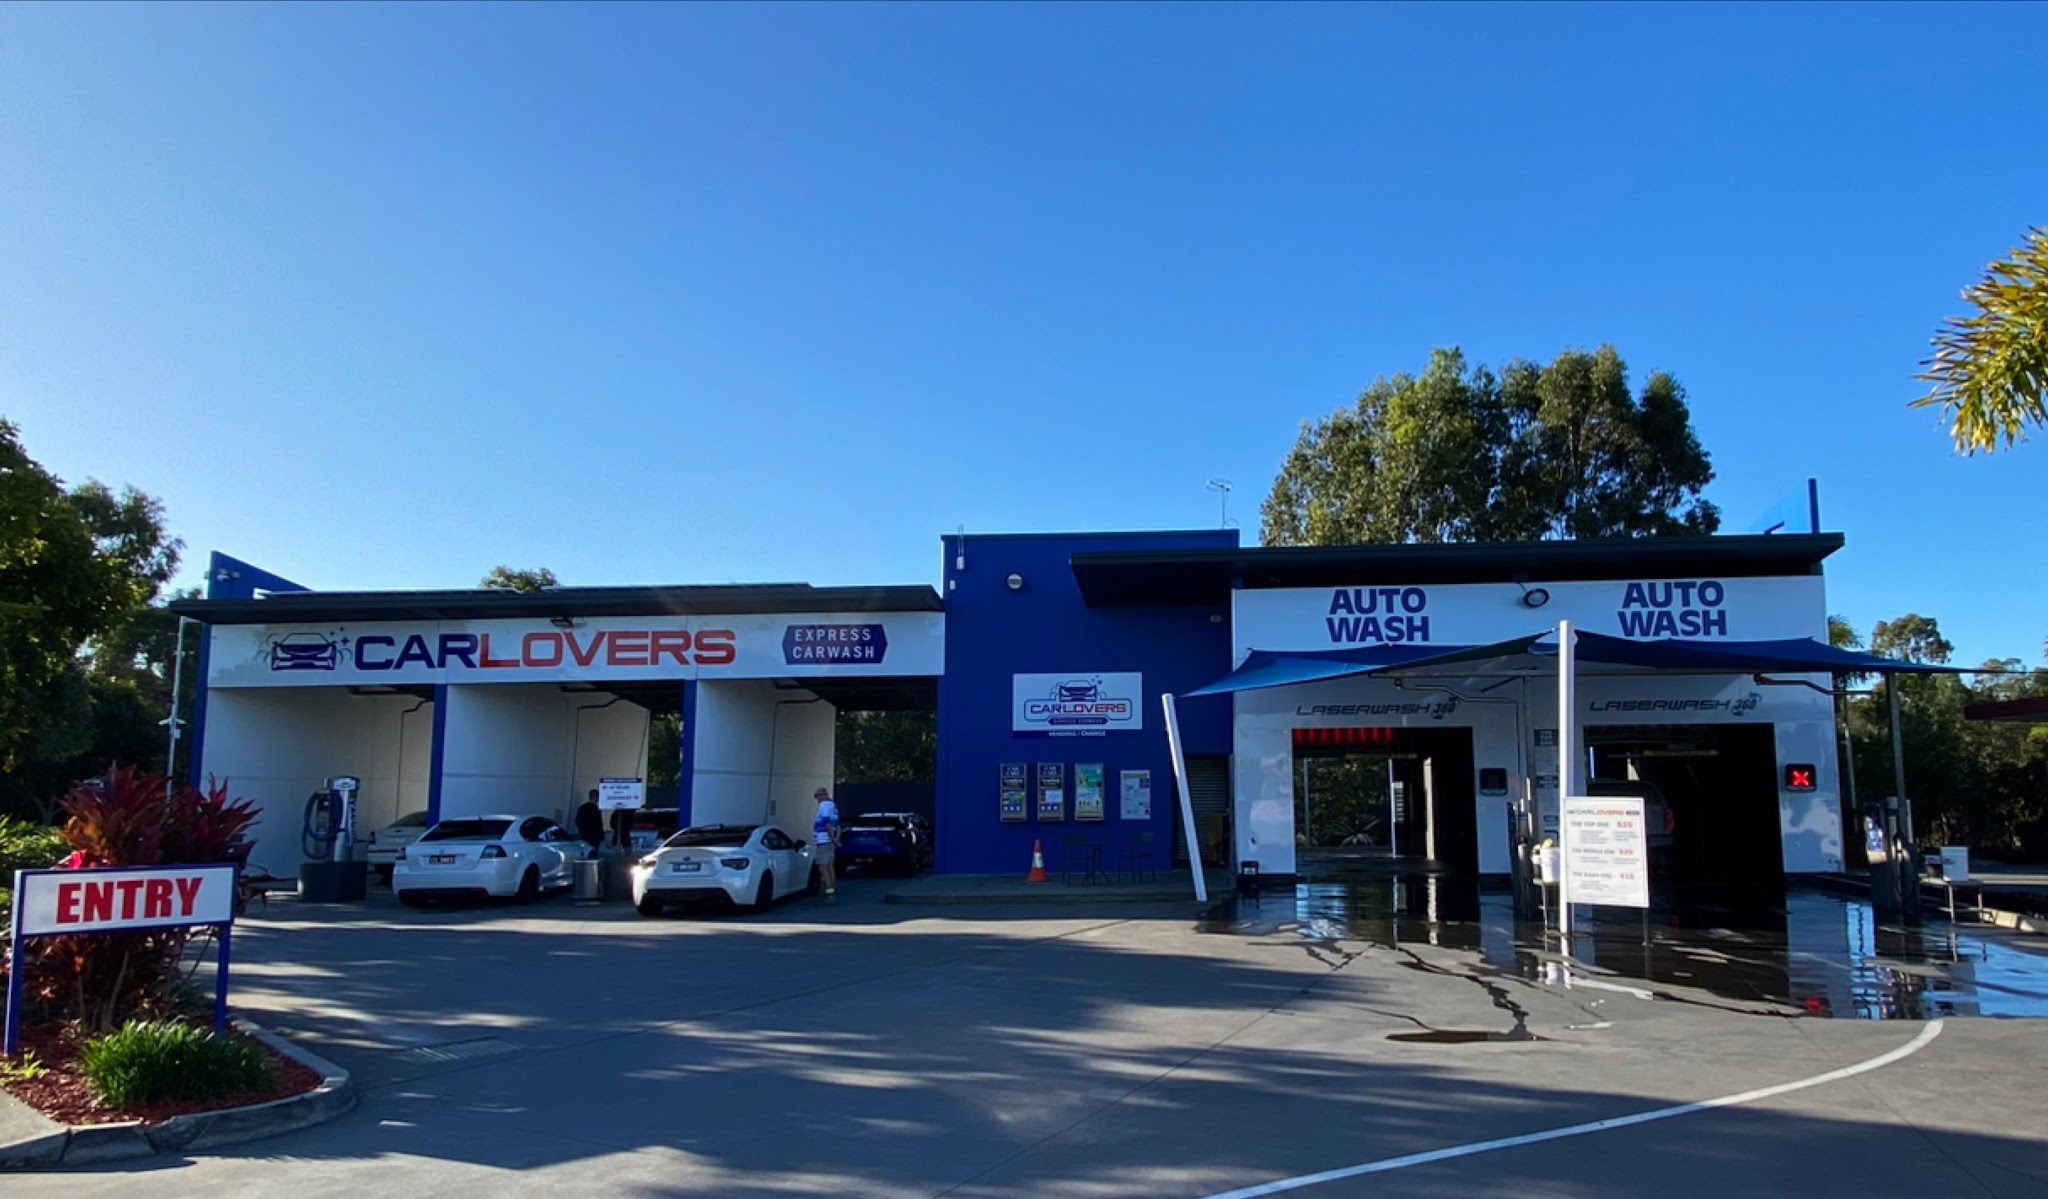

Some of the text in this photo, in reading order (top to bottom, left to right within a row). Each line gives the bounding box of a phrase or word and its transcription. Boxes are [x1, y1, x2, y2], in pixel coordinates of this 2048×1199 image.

[1329, 587, 1427, 615] AUTO
[1622, 580, 1725, 608] AUTO
[794, 628, 872, 642] EXPRESS
[1325, 615, 1430, 643] WASH
[1617, 609, 1727, 637] WASH
[354, 629, 736, 671] CARLOVERS
[792, 645, 875, 659] CARWASH
[1030, 703, 1127, 714] CARLOVERS
[1296, 703, 1430, 716] LASERWASH
[1590, 699, 1731, 712] LASERWASH
[56, 876, 203, 924] ENTRY
